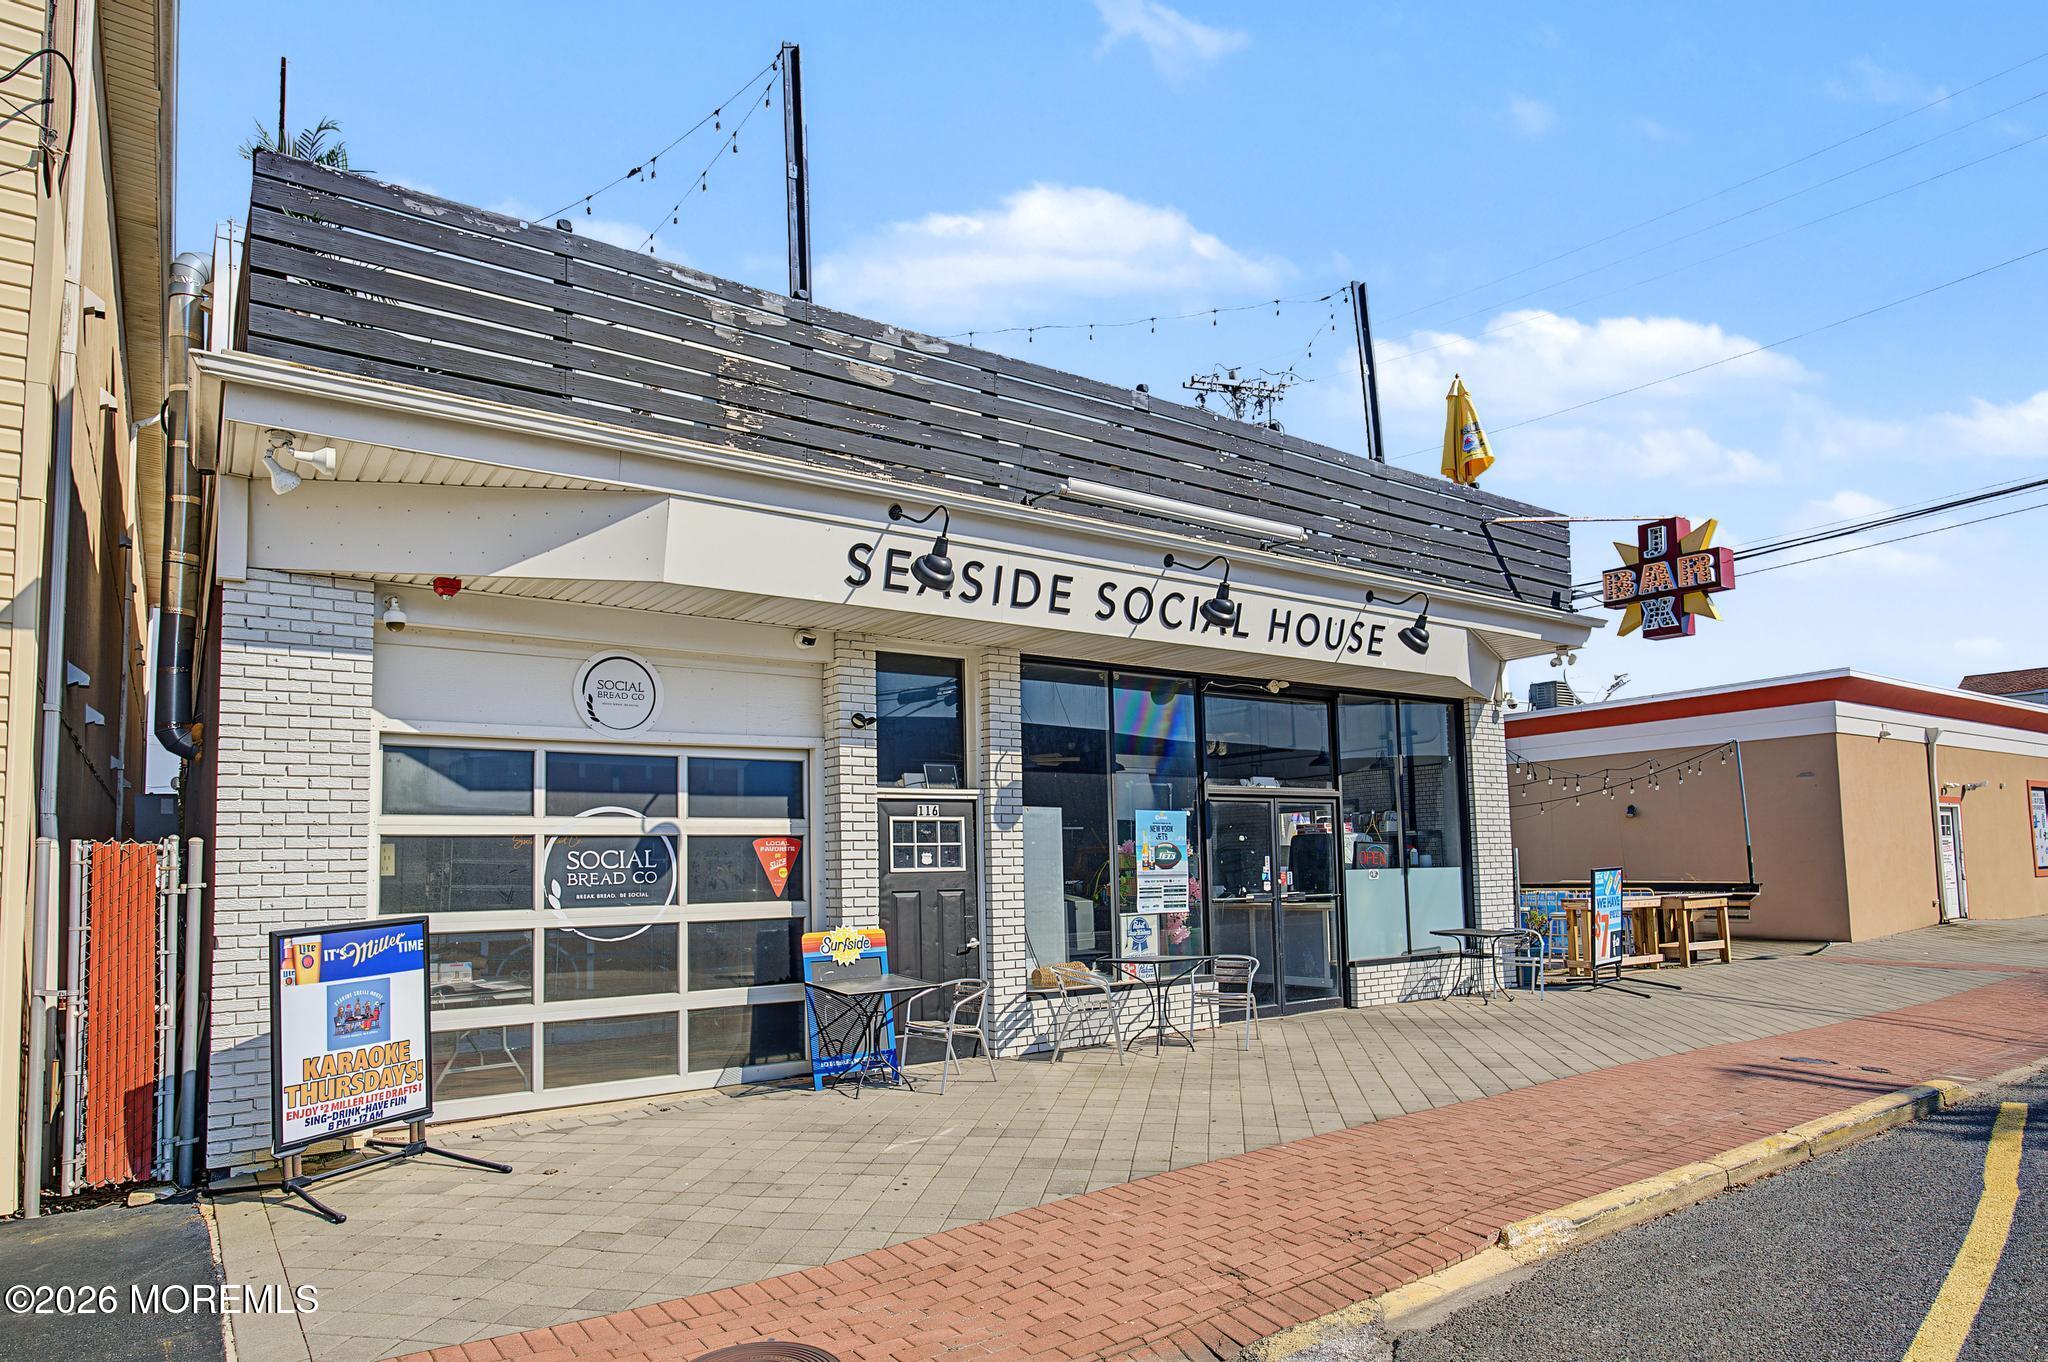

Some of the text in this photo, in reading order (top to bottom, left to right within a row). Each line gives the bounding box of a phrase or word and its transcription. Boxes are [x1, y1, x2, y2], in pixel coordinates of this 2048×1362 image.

[1603, 553, 1716, 601] BAR
[845, 543, 1074, 614] SESIDE
[1268, 608, 1386, 656] HOUSE
[597, 679, 645, 692] SOCIAL
[597, 690, 645, 701] BREAD CO
[918, 805, 938, 816] 116
[566, 849, 657, 870] SOCIAL
[1360, 851, 1386, 865] OPEN
[567, 871, 658, 887] BREAD CO
[1596, 895, 1620, 909] WE HAVE
[324, 932, 424, 967] IT'S Miller TIME
[819, 935, 871, 954] Surfside
[303, 1039, 410, 1082] KARAOKE
[284, 1059, 424, 1109] THURSDAYS!
[286, 1106, 318, 1121] ENJOY
[320, 1104, 329, 1113] $2
[331, 1096, 364, 1111] MILLER
[365, 1091, 384, 1103] LITE
[390, 1096, 407, 1108] FUN
[336, 1117, 350, 1128] PM
[359, 1113, 368, 1123] 12
[369, 1110, 384, 1120] AM
